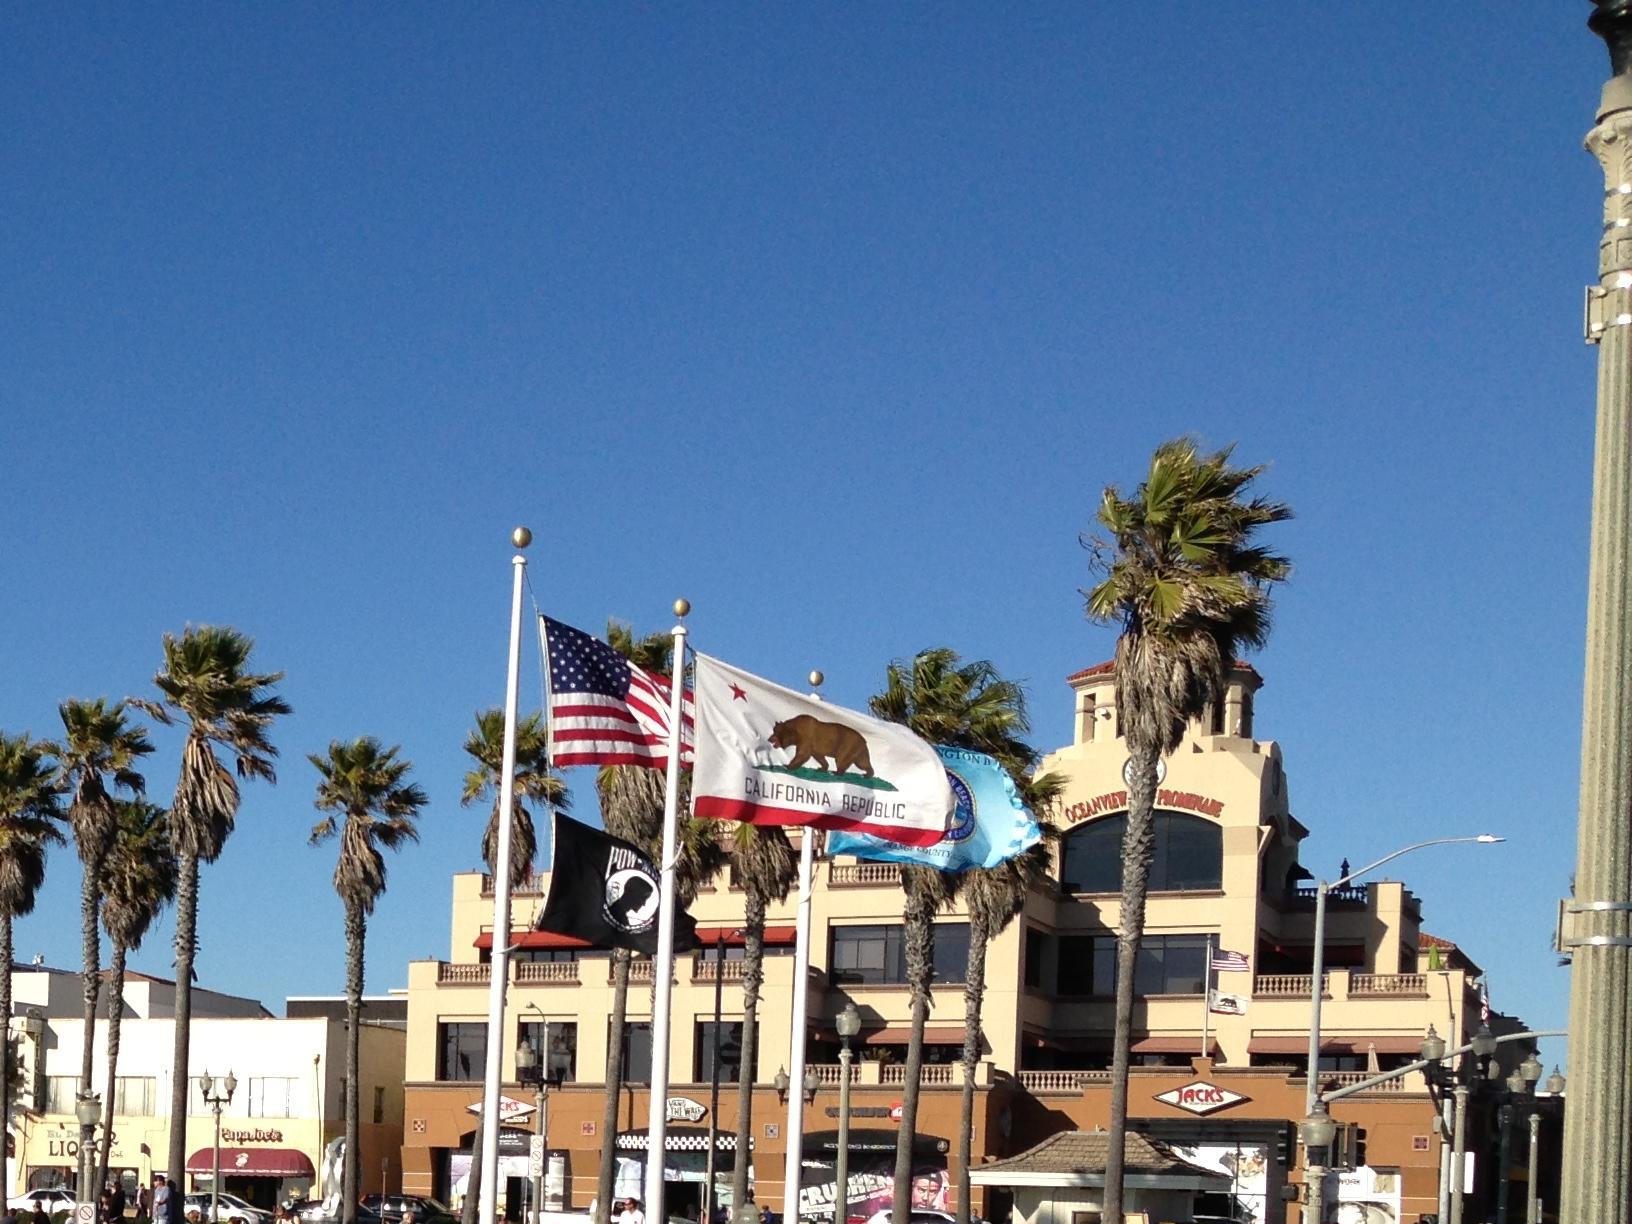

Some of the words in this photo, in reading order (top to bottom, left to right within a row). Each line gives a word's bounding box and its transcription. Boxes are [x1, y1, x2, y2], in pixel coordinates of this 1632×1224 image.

[745, 777, 832, 808] CALIFORNIA
[842, 794, 906, 820] REPUBLIC
[1065, 790, 1128, 824] OCEANVIEW
[1157, 789, 1226, 819] PROMENADE
